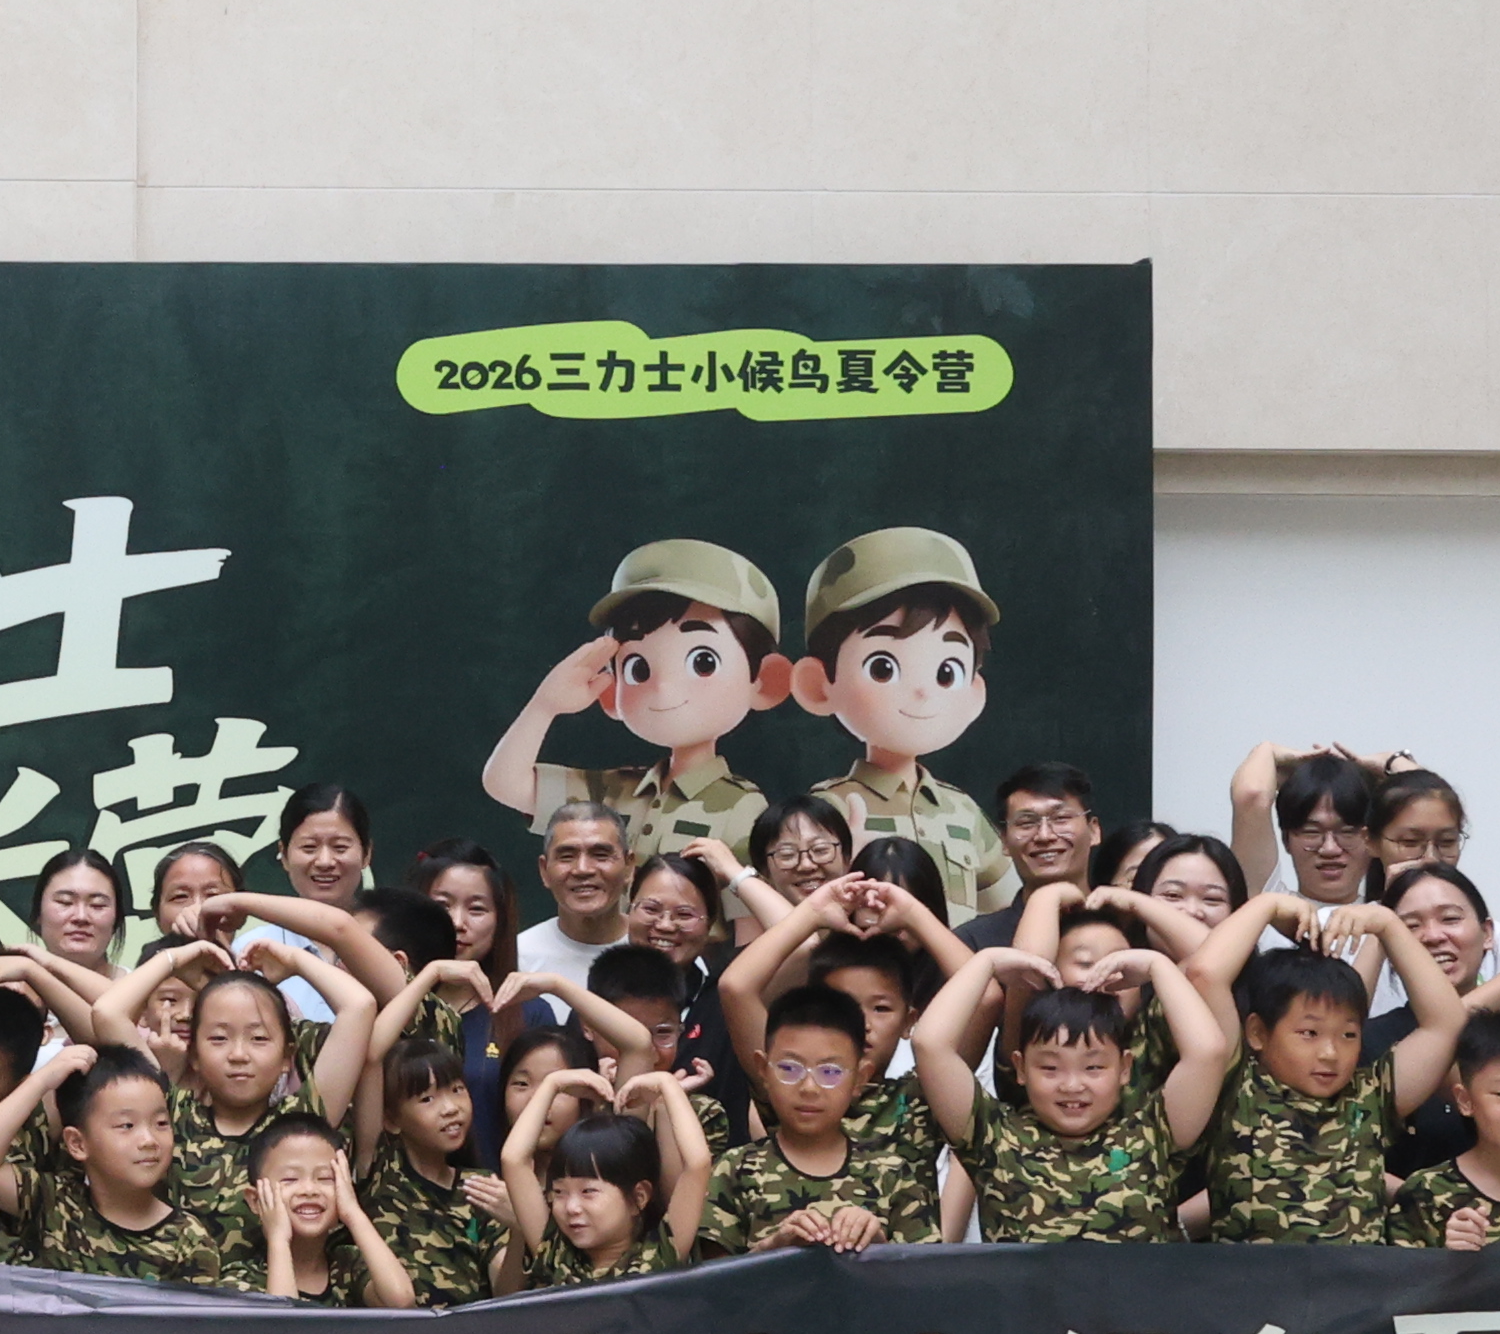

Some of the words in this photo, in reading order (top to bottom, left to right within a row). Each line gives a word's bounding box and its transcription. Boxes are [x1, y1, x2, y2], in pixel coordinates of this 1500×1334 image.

[434, 348, 975, 395] 2026三力士小候鸟夏令营
